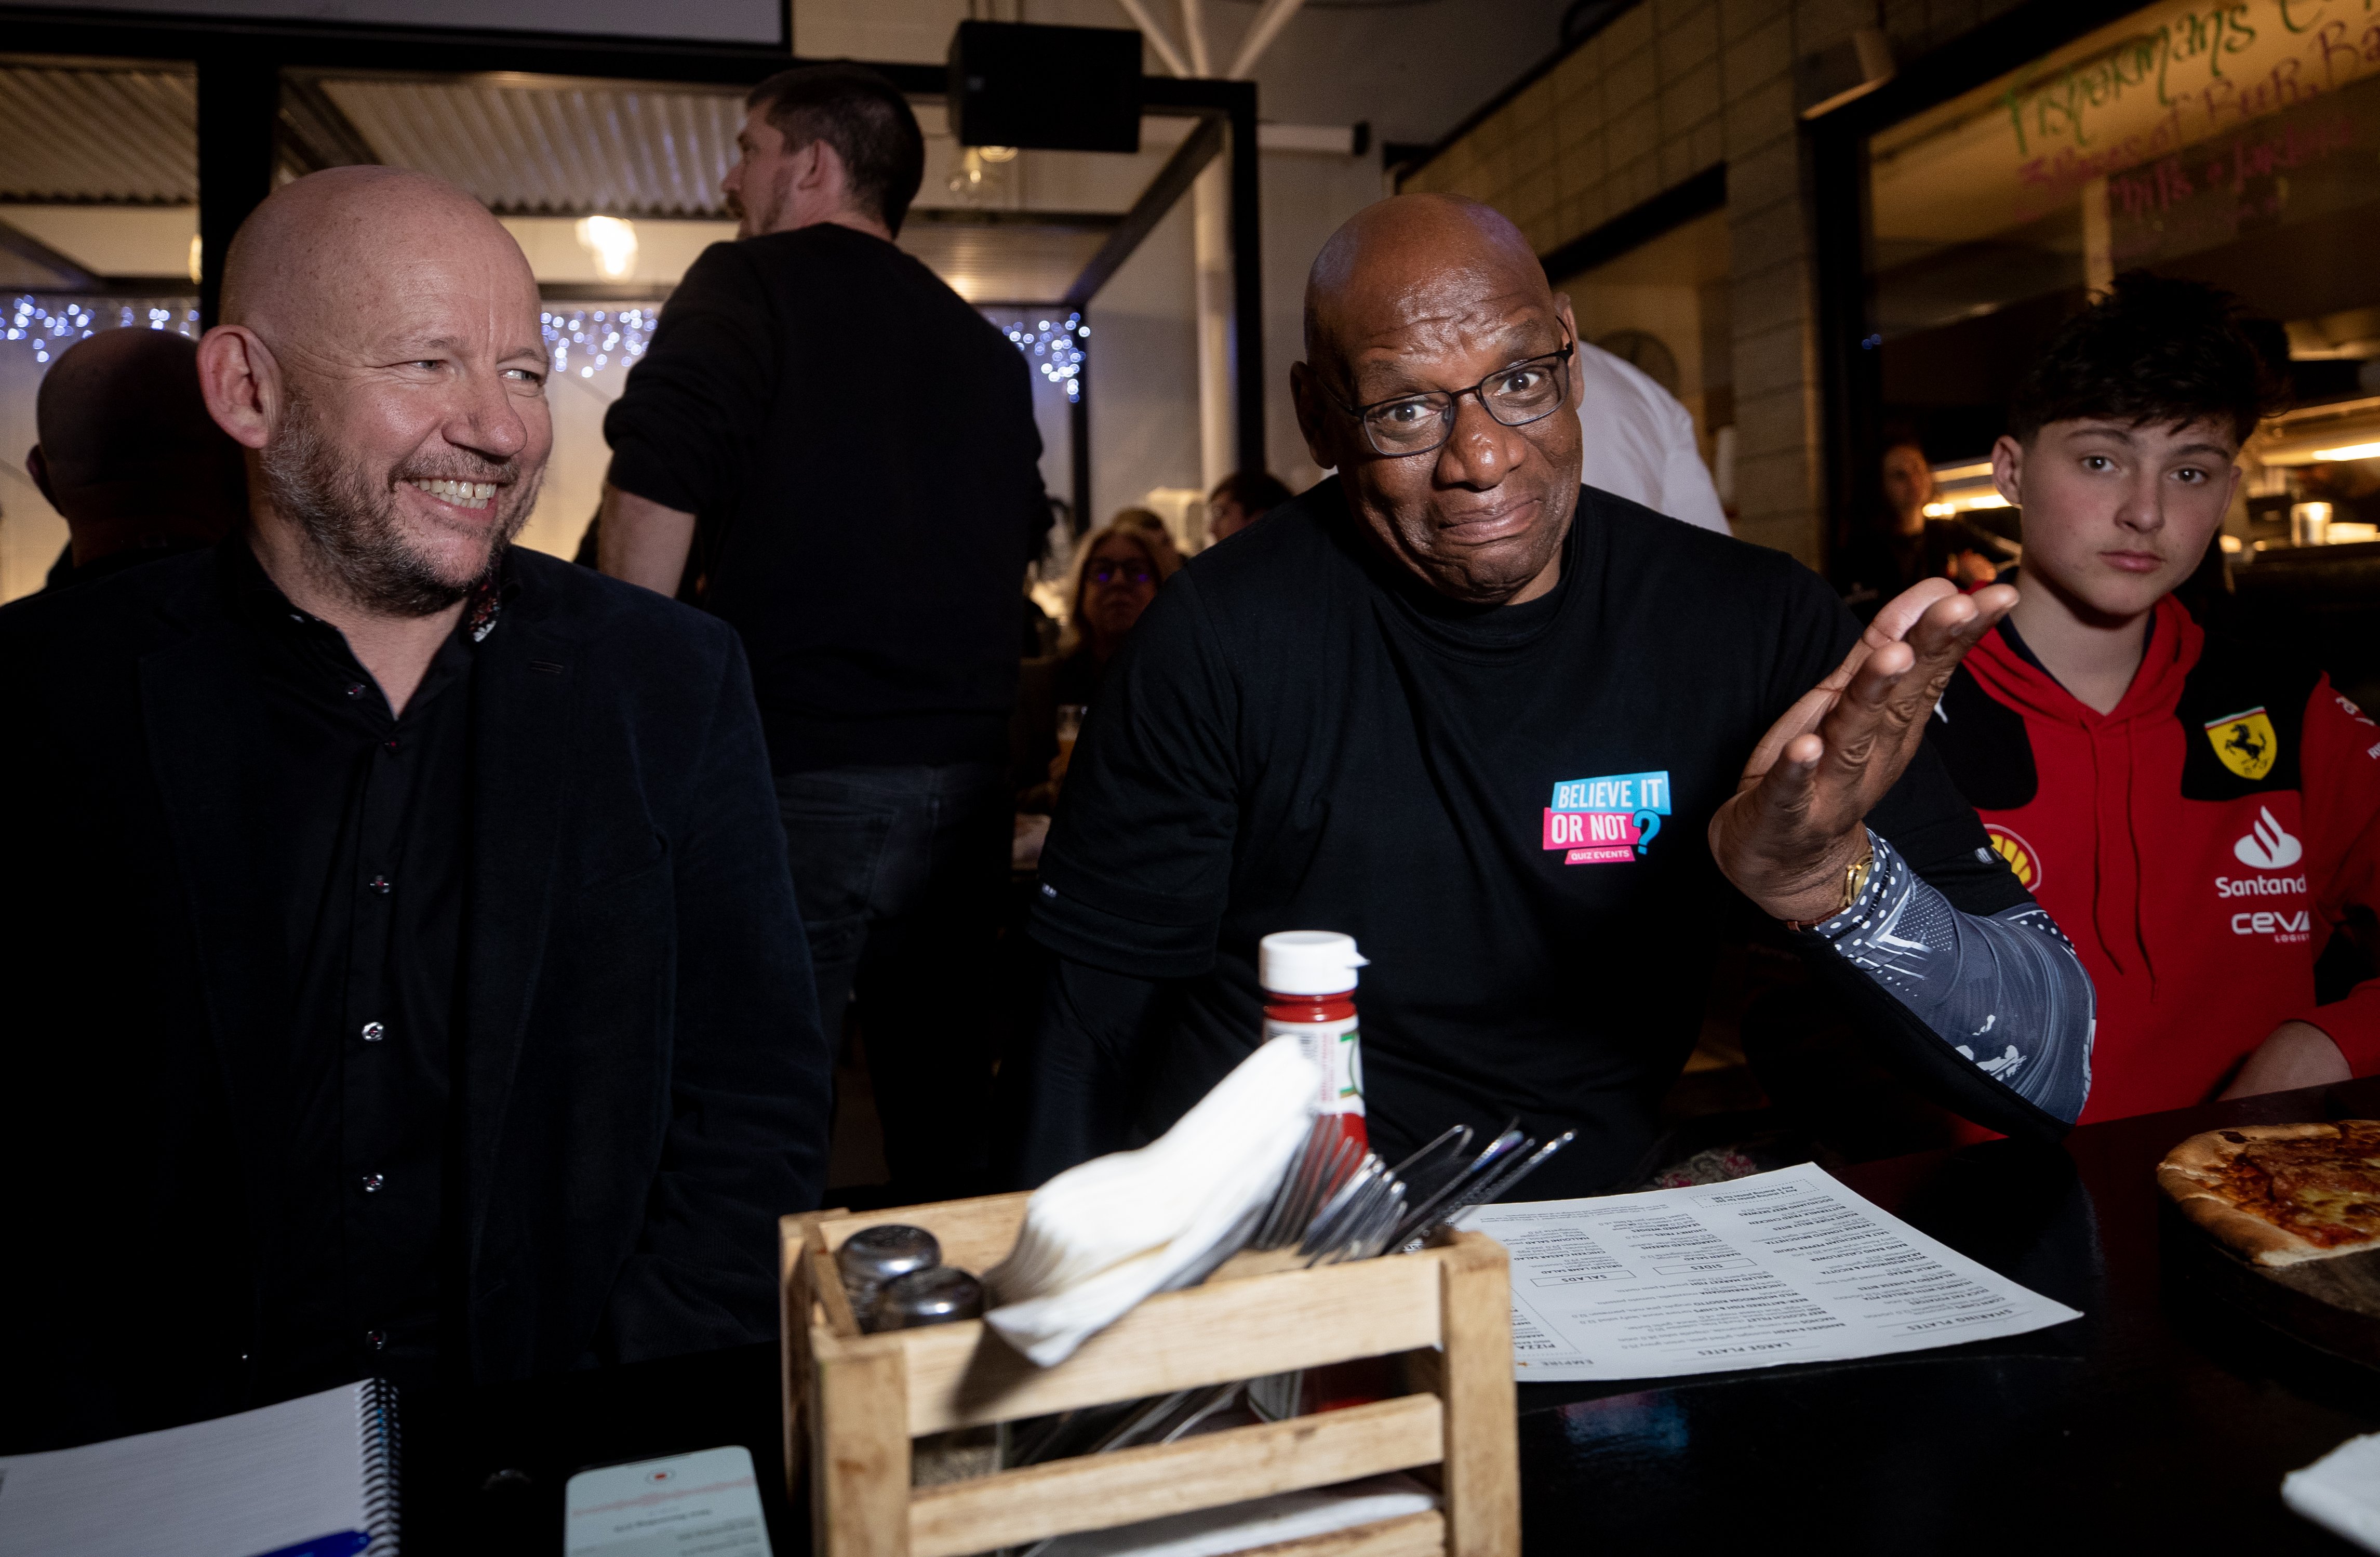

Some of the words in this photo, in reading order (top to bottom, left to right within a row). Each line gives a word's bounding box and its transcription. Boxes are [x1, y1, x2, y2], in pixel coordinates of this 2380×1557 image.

[1558, 780, 1633, 808] BELIEVE
[1641, 778, 1663, 808] IT
[1552, 814, 1584, 844] OR
[1590, 815, 1627, 841] NOT
[1571, 851, 1592, 861] QUIZ
[1594, 849, 1630, 859] EVENTS
[1787, 1197, 1835, 1209] GOCHUJANG
[1802, 1205, 1847, 1216] BUTTERMILK
[1843, 1222, 1877, 1231] CAPRESE
[1811, 1229, 1844, 1237] TOMATO
[1669, 1239, 1723, 1247] CHARGRILLED
[1764, 1234, 1813, 1245] BRUSCHETTA
[1823, 1235, 1866, 1245] SZECHUAN
[1809, 1250, 1864, 1261] CAULIFLOWER
[1882, 1252, 1923, 1261] ARANCINI
[1860, 1259, 1907, 1269] MUSHROOM
[1915, 1273, 1958, 1283] JALAPEÑO
[1935, 1281, 1974, 1290] HUMMUS
[1728, 1294, 1779, 1302] MUSHROOM
[1745, 1298, 1810, 1308] BEER-BATTERED
[1908, 1296, 1951, 1305] POTATOES
[1953, 1309, 2015, 1323] SHARING
[1905, 1319, 1954, 1330] PLATES
[1747, 1341, 1792, 1350] LARGE
[1696, 1347, 1746, 1355] PLATES
